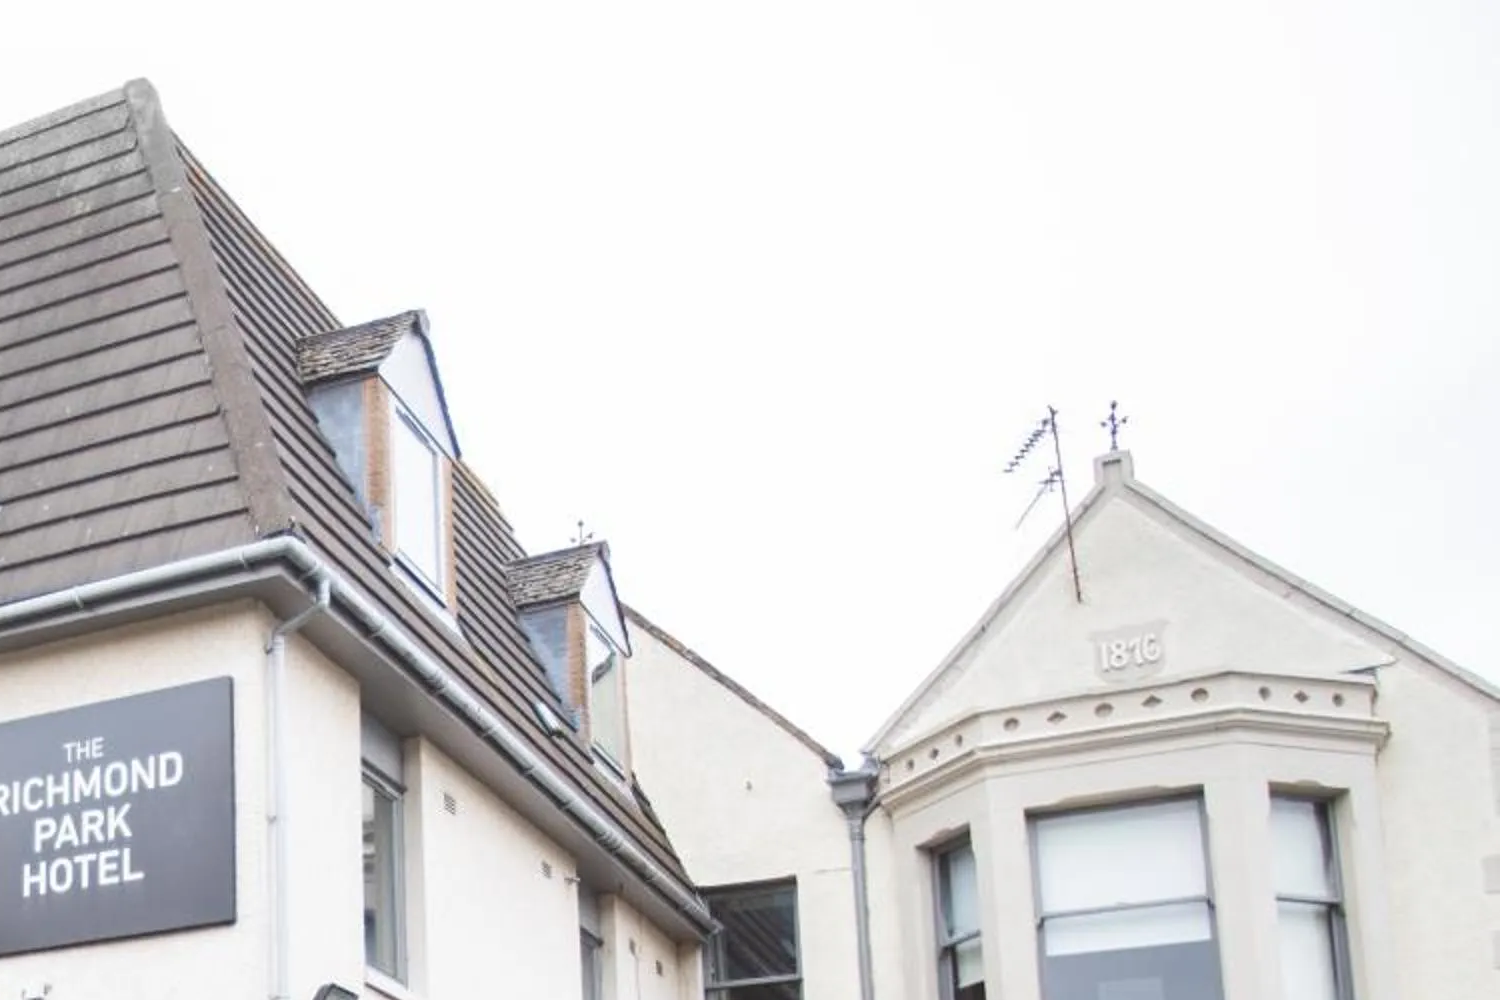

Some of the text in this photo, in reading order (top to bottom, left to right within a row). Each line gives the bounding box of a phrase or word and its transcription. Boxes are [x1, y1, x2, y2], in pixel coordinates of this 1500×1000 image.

[63, 737, 105, 763] THE
[32, 803, 133, 853] PARK
[22, 847, 145, 898] HOTEL
